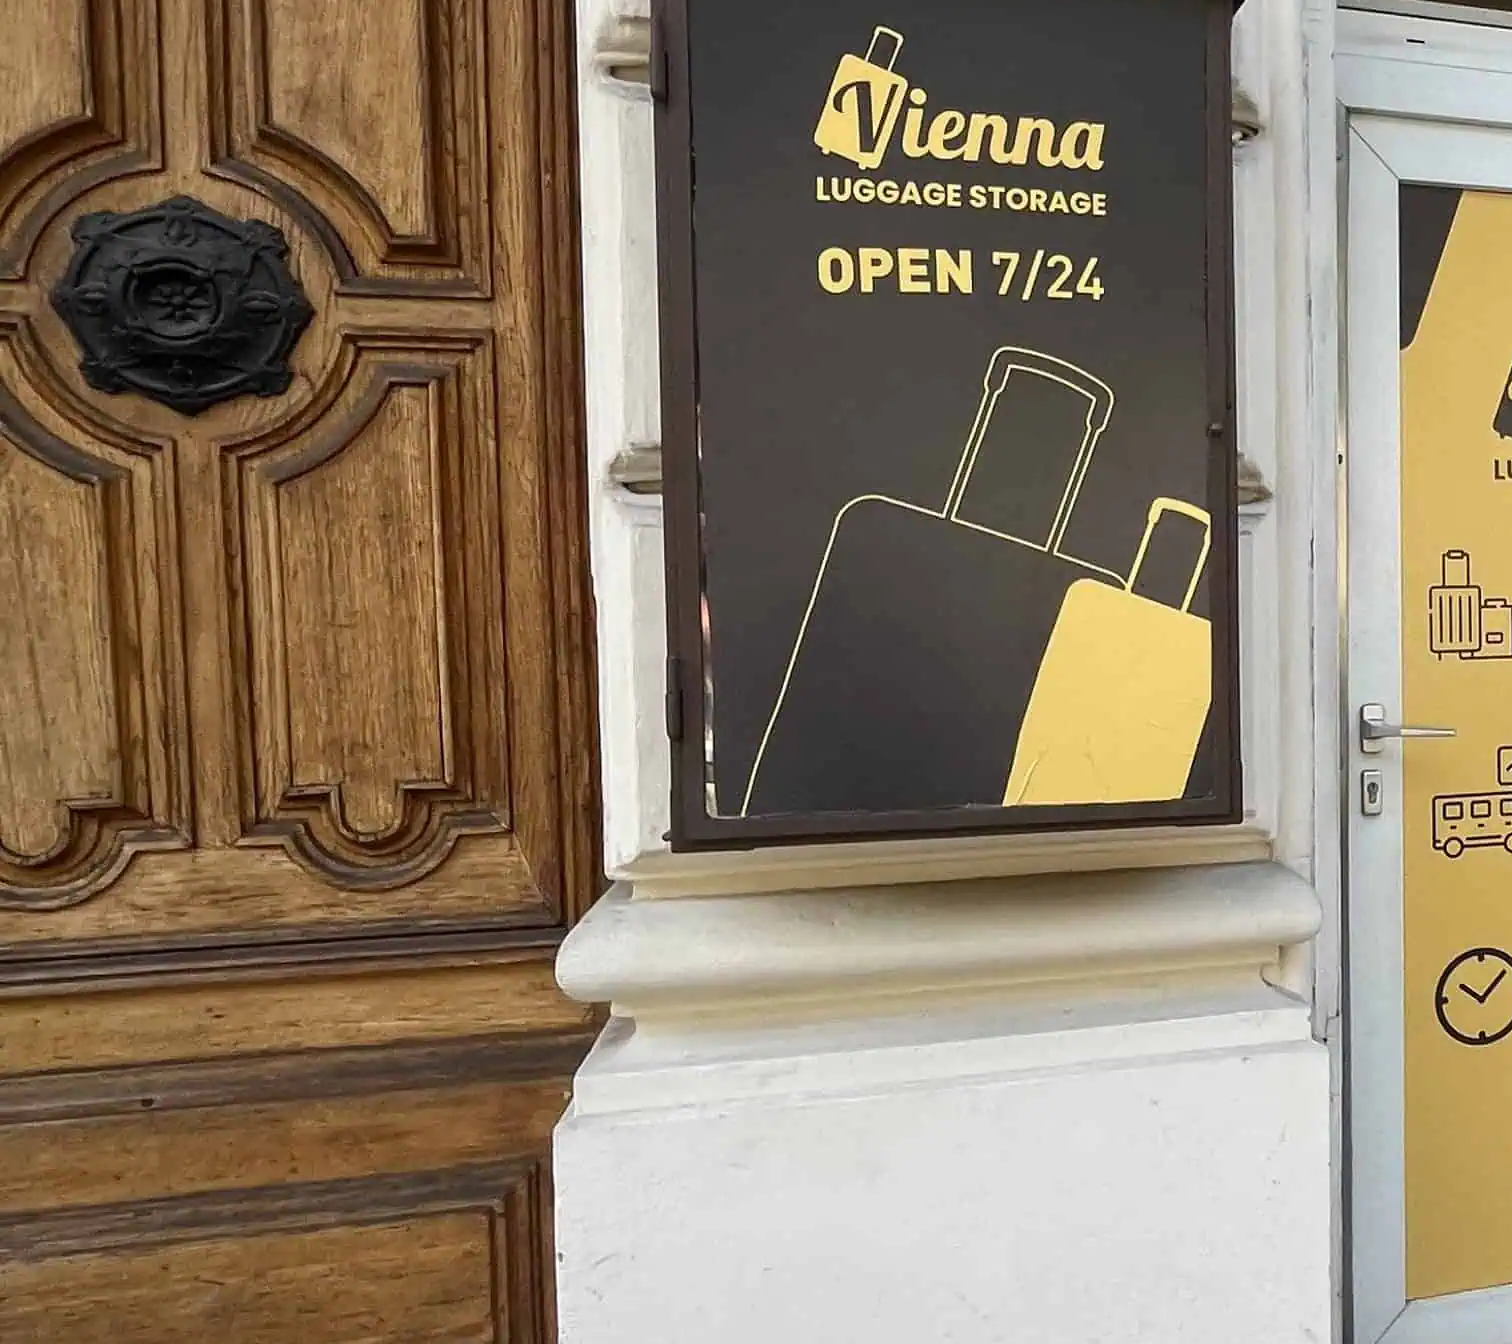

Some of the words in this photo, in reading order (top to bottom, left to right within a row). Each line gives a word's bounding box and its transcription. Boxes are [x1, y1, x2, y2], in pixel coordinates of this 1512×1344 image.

[832, 80, 1105, 170] Vienna
[816, 176, 961, 207] LUGGAGE
[968, 184, 1107, 216] STORAGE
[817, 246, 973, 294] OPEN
[991, 249, 1105, 301] 7/24
